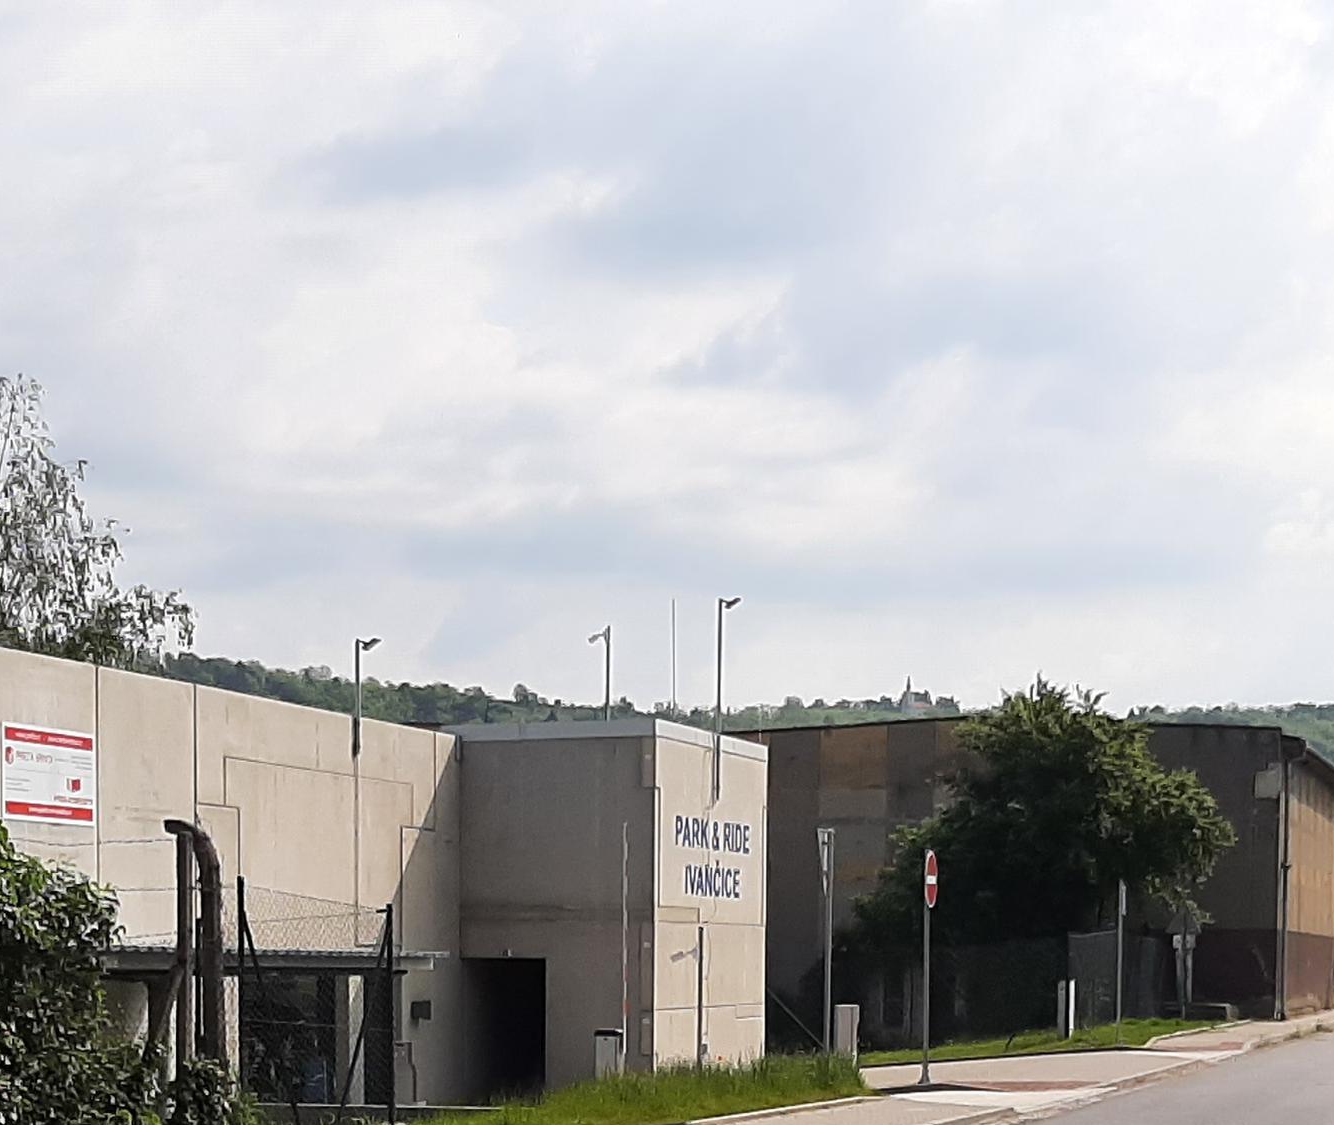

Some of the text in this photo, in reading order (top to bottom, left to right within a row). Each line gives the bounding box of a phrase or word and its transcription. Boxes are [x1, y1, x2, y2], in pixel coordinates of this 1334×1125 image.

[675, 815, 750, 854] PARK & RIDE
[684, 860, 740, 899] IVANČICE
